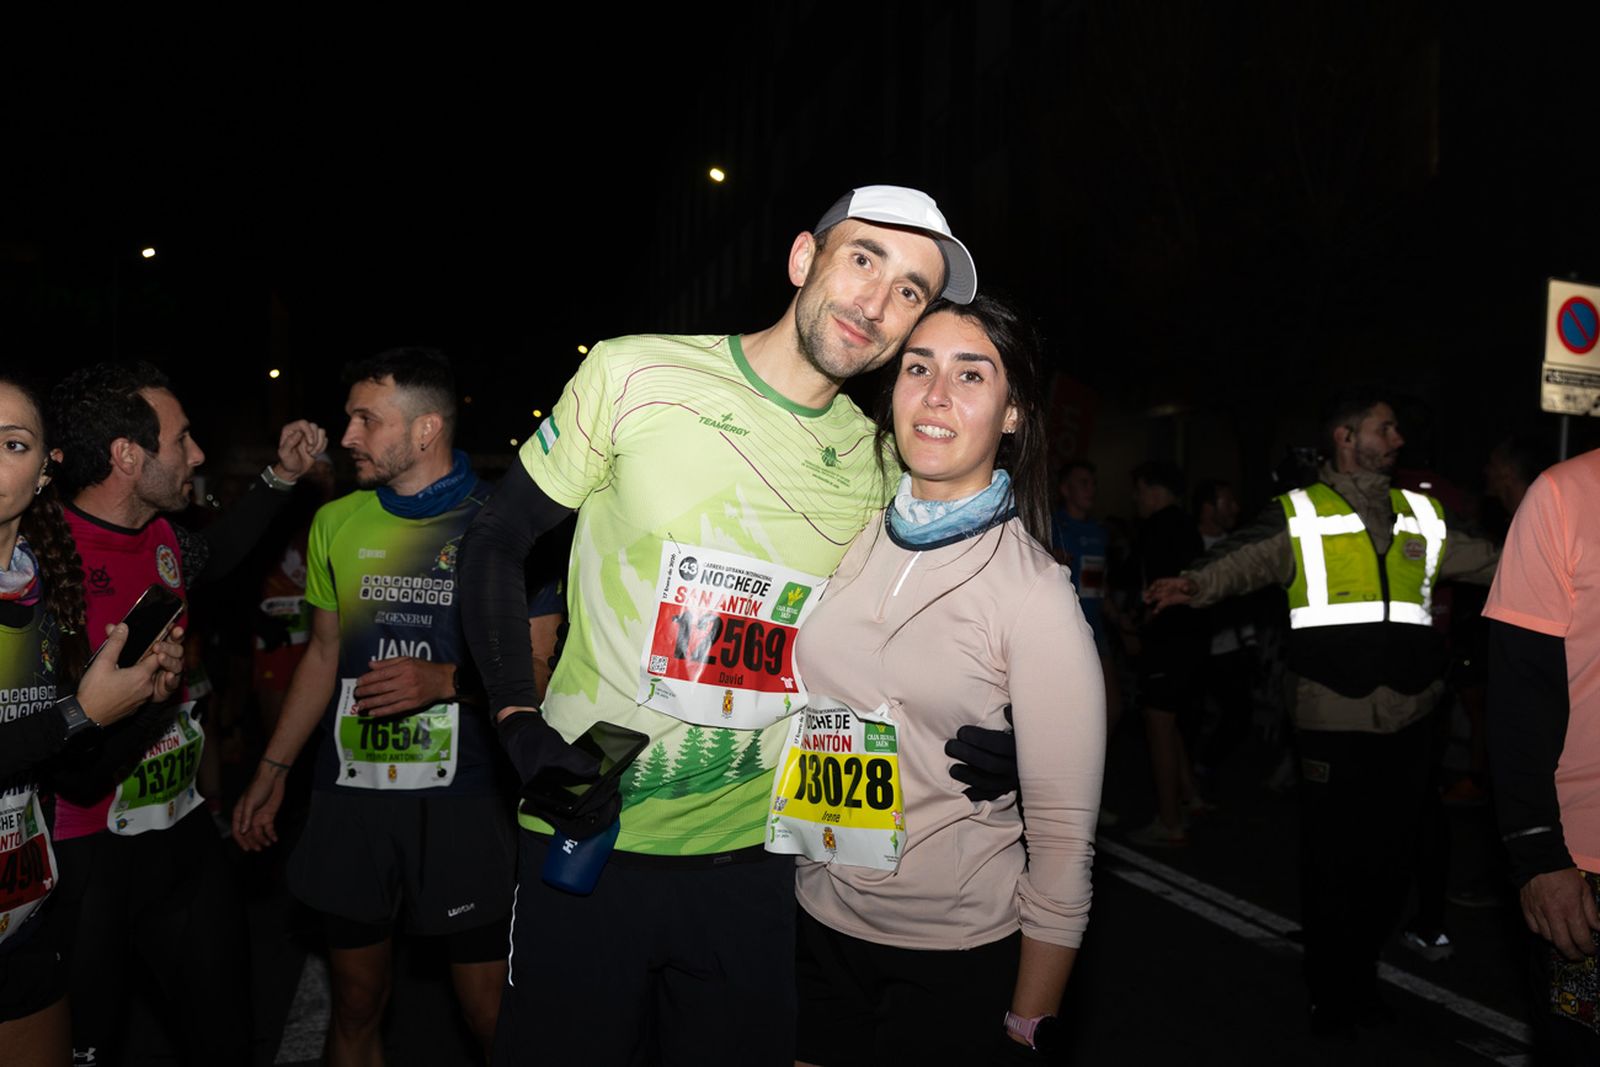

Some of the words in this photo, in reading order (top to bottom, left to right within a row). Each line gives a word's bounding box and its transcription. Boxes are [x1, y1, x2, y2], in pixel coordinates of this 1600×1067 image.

[699, 416, 750, 437] TEAMERGY
[680, 561, 698, 575] 43
[700, 570, 750, 593] NOCHE
[750, 579, 771, 597] DE
[674, 586, 713, 608] SAN
[715, 594, 762, 617] ANTÓN
[385, 612, 433, 625] GENERALI
[672, 610, 786, 675] 12569
[719, 671, 744, 686] David
[357, 716, 432, 751] 7654
[835, 714, 850, 730] DE
[813, 730, 852, 752] ANTÓN
[134, 743, 196, 798] 13215
[794, 754, 894, 810] 13028
[821, 811, 842, 823] Irene
[0, 841, 43, 893] 490
